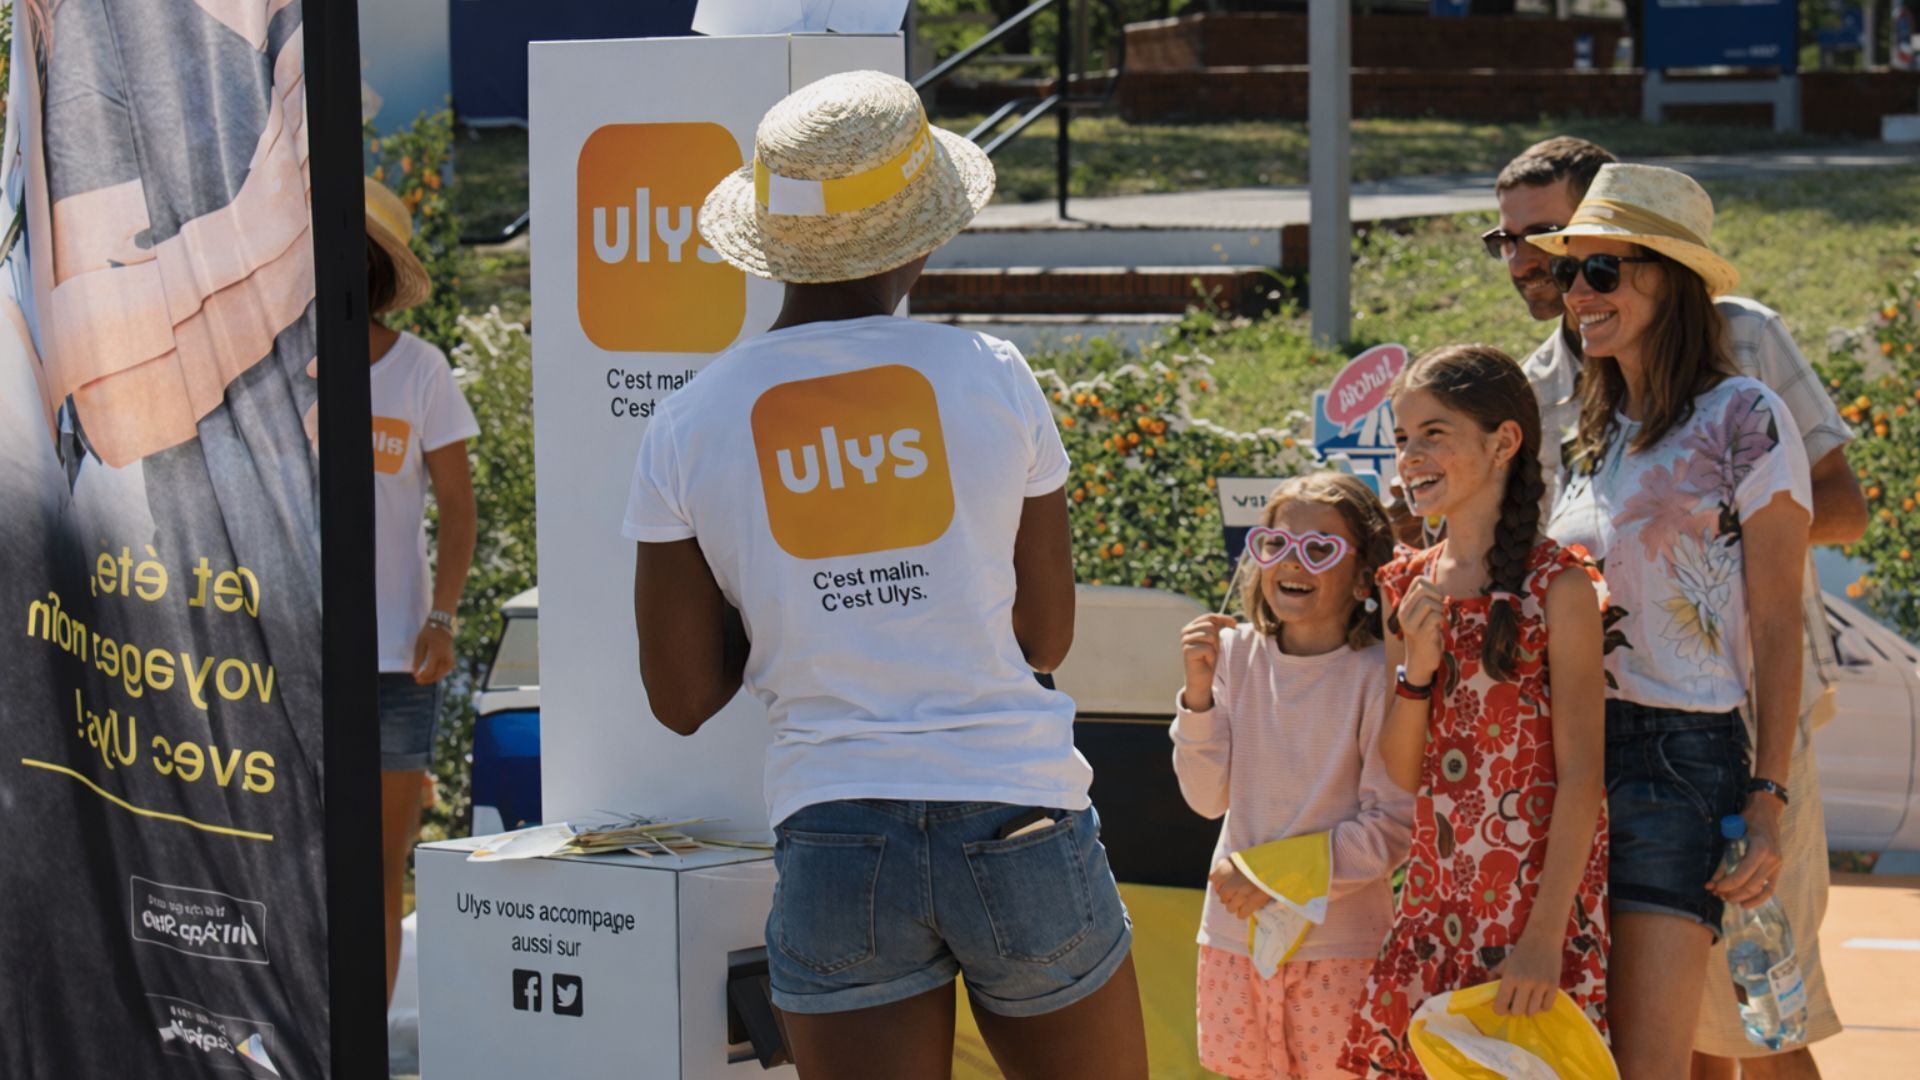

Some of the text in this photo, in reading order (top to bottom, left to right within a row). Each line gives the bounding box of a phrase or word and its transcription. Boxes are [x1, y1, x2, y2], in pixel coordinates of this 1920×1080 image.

[606, 368, 652, 389] C'est
[611, 397, 656, 418] C'est
[776, 426, 929, 494] ulys
[813, 560, 930, 590] C'est malin.
[821, 583, 928, 612] C'est Ulys.
[456, 892, 492, 920] Ulys
[495, 899, 535, 920] vous
[512, 934, 581, 958] aussi sur
